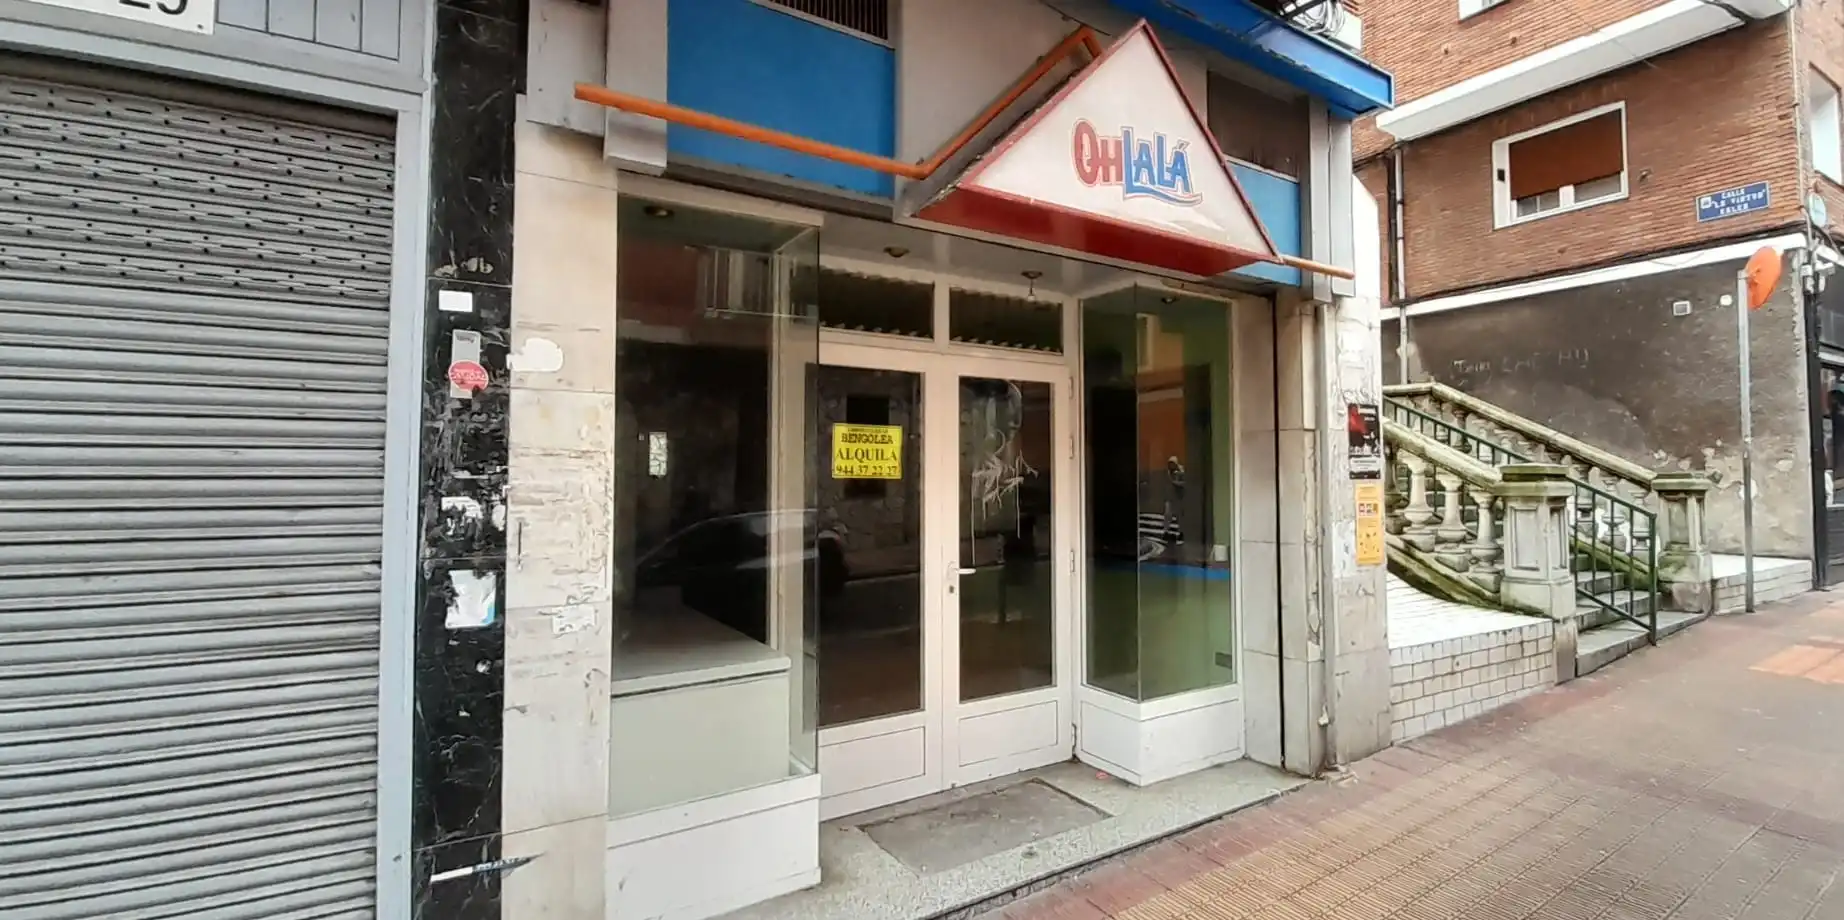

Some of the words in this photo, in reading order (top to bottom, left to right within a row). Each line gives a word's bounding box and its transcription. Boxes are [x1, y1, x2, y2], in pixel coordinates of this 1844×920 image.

[841, 433, 894, 445] BENGOLEA
[835, 447, 897, 463] ALQUILA
[836, 464, 854, 474] 944
[858, 464, 869, 474] 37
